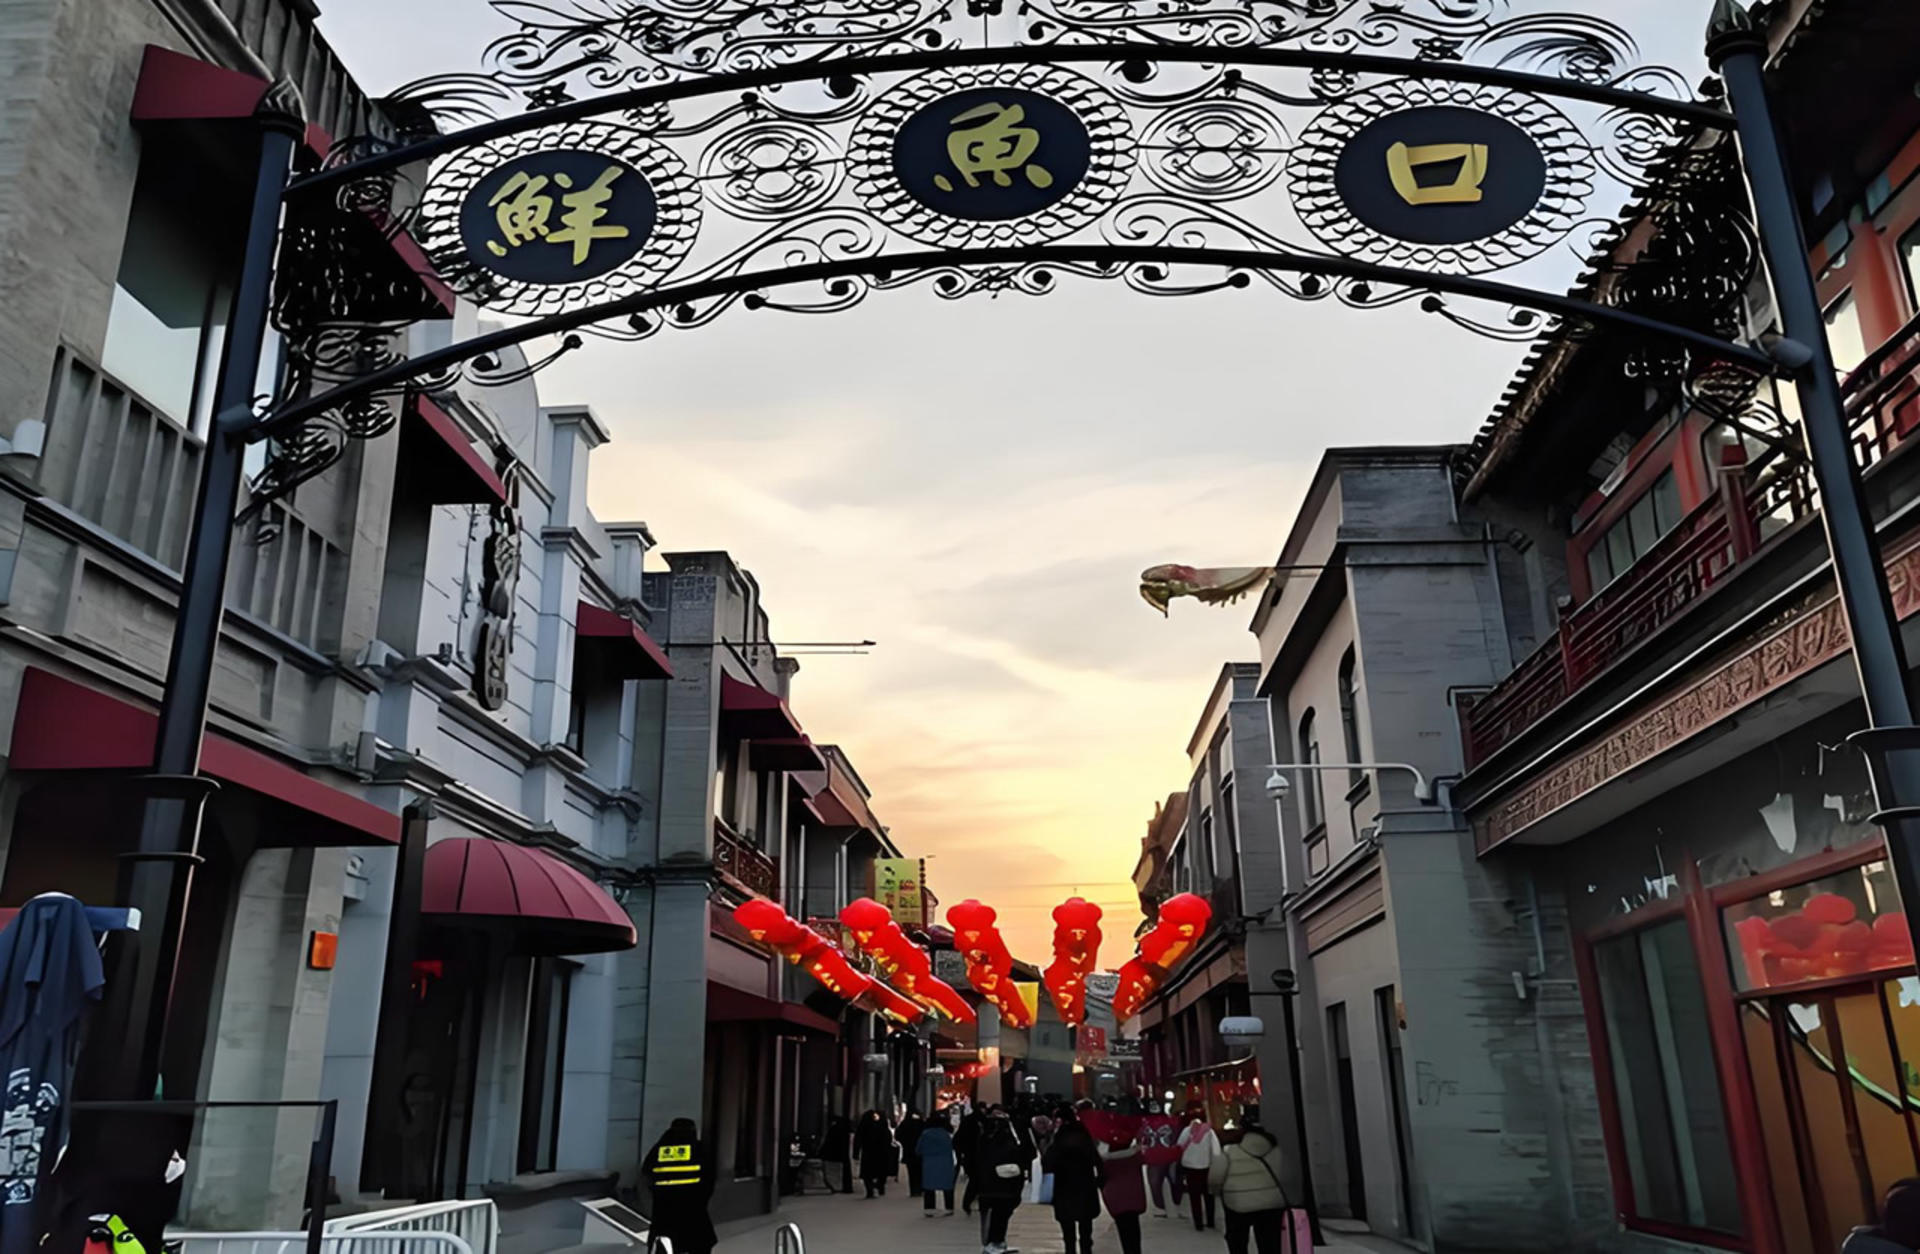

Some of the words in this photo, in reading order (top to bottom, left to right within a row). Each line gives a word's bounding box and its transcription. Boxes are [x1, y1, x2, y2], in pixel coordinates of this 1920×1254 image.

[487, 165, 629, 266] 鮮
[934, 102, 1053, 192] 魚
[1386, 141, 1488, 206] 口
